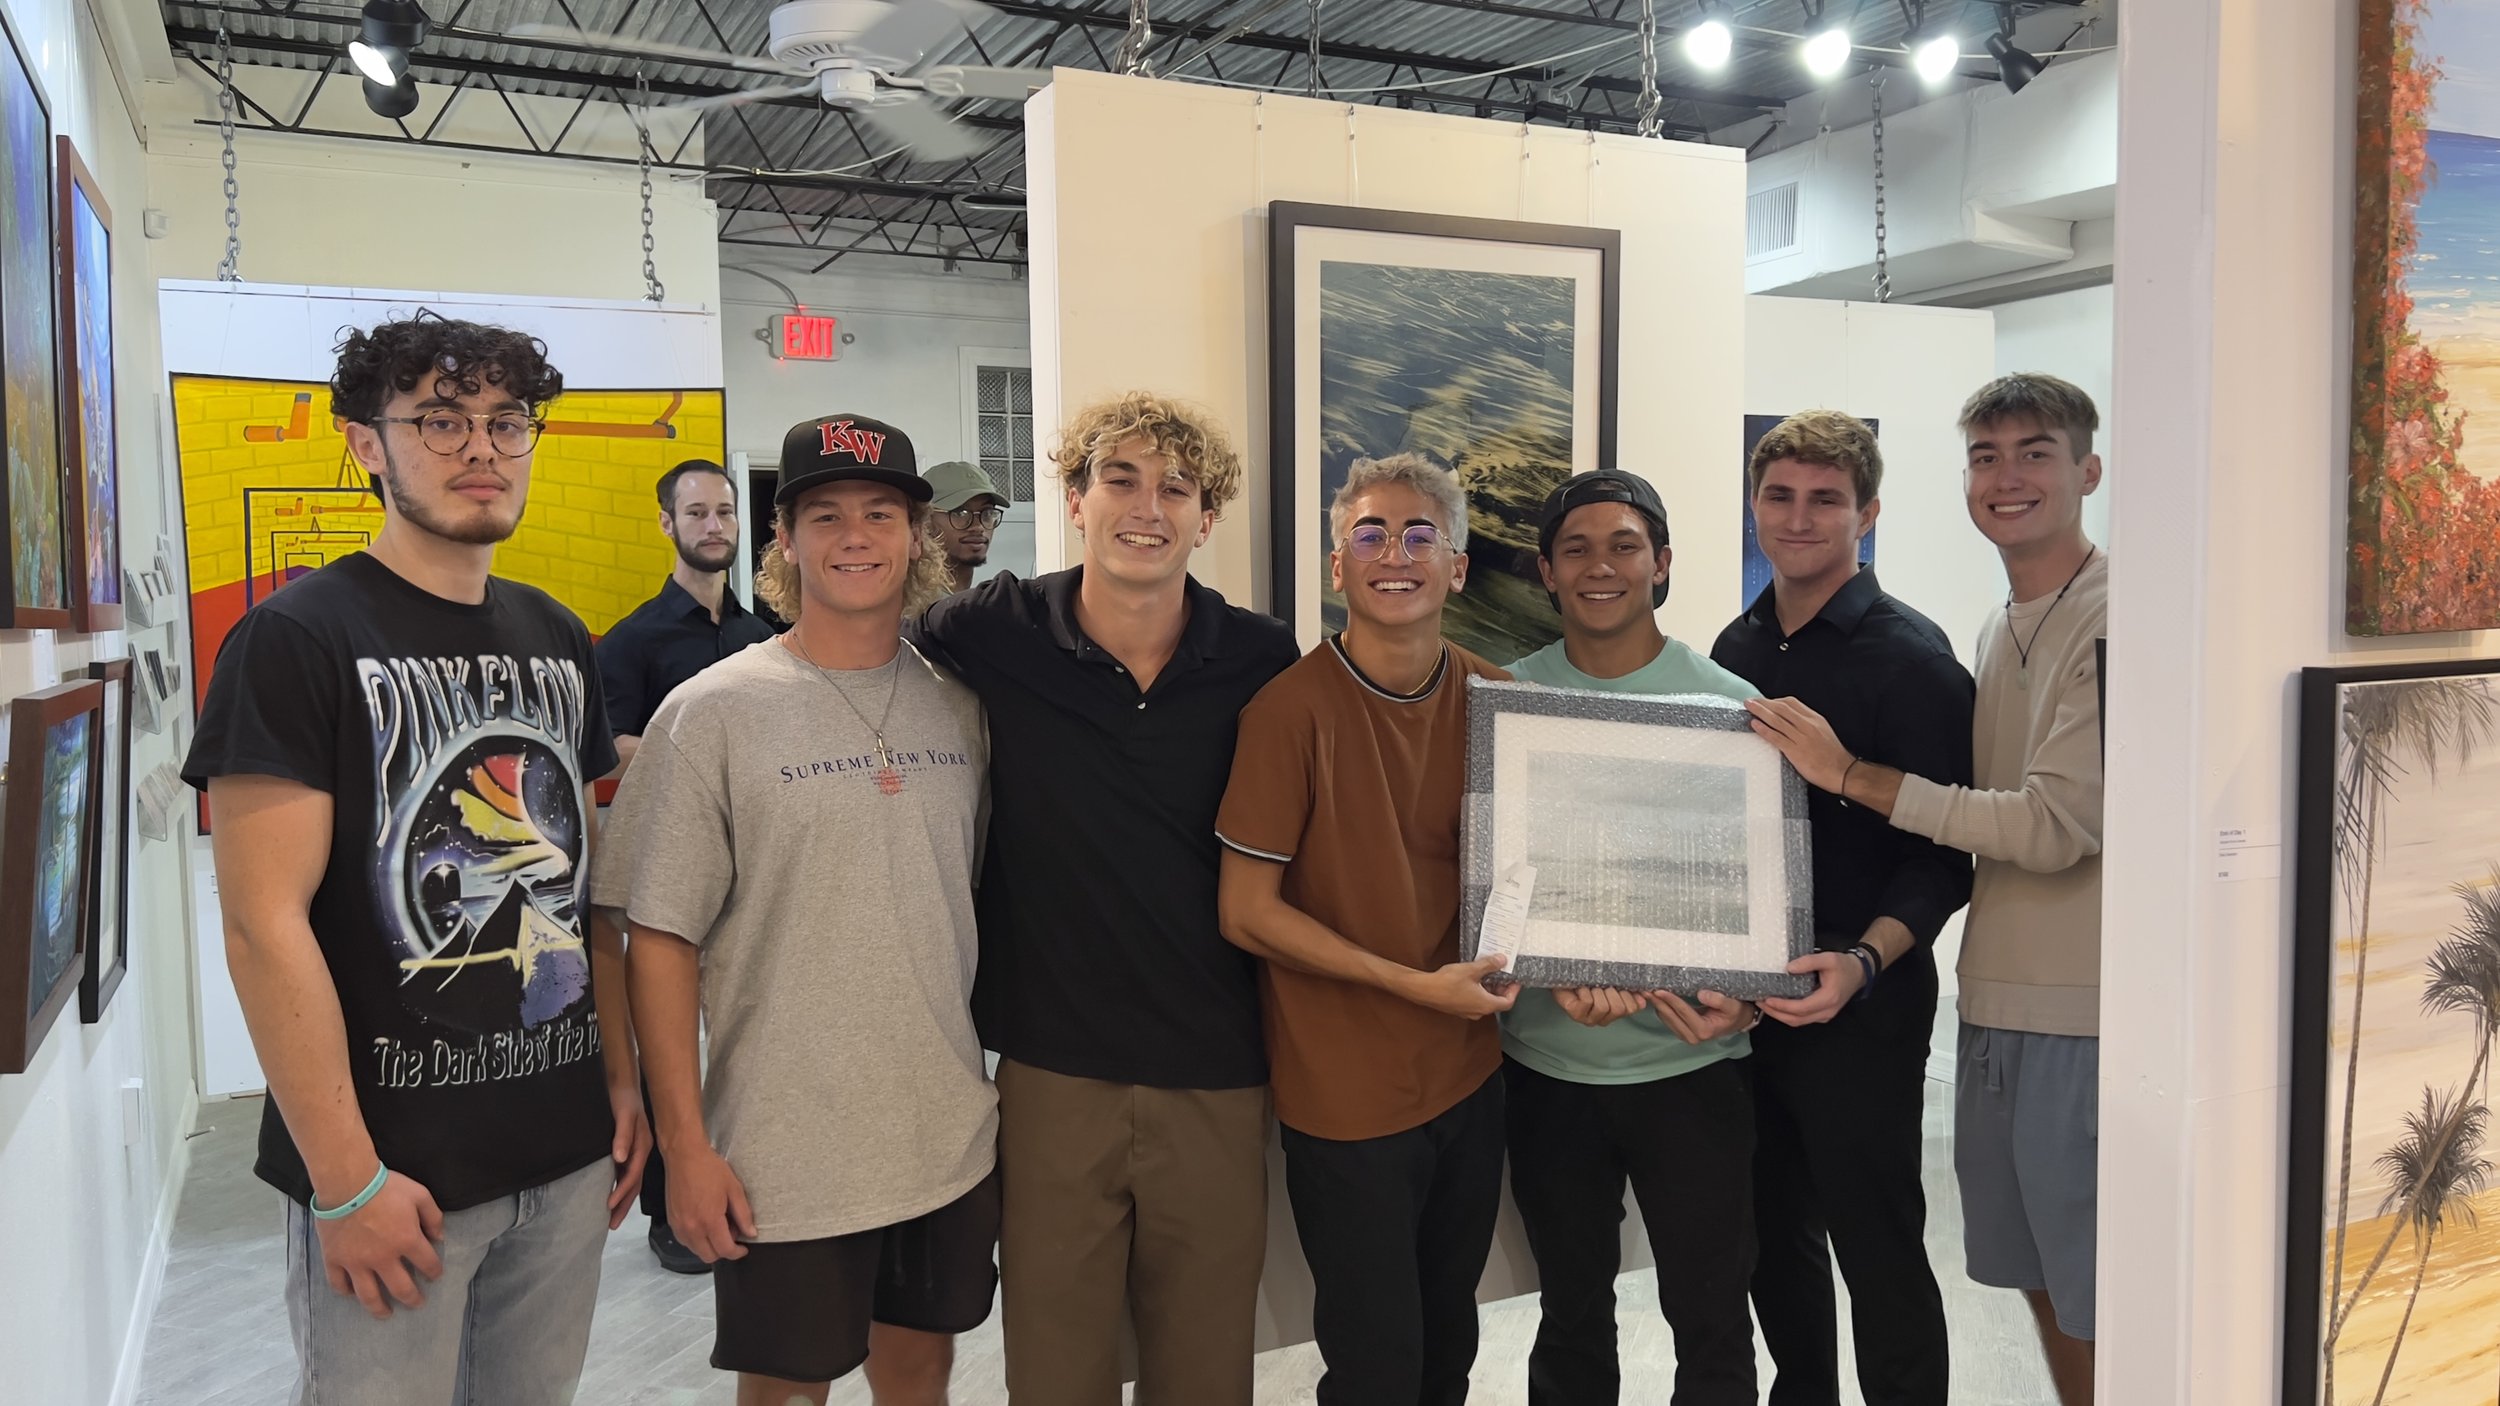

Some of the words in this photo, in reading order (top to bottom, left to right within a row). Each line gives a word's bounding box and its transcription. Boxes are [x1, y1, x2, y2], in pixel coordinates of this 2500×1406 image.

[783, 315, 836, 358] EXIT
[817, 420, 886, 465] KW
[356, 654, 481, 848] PINK
[780, 755, 874, 783] SUPREME
[879, 750, 919, 767] NEW
[926, 749, 967, 766] YORK
[373, 1036, 424, 1087] The
[430, 1034, 487, 1086] Dark
[492, 1028, 535, 1080] Side
[535, 1023, 551, 1073] of
[554, 1018, 585, 1066] the
